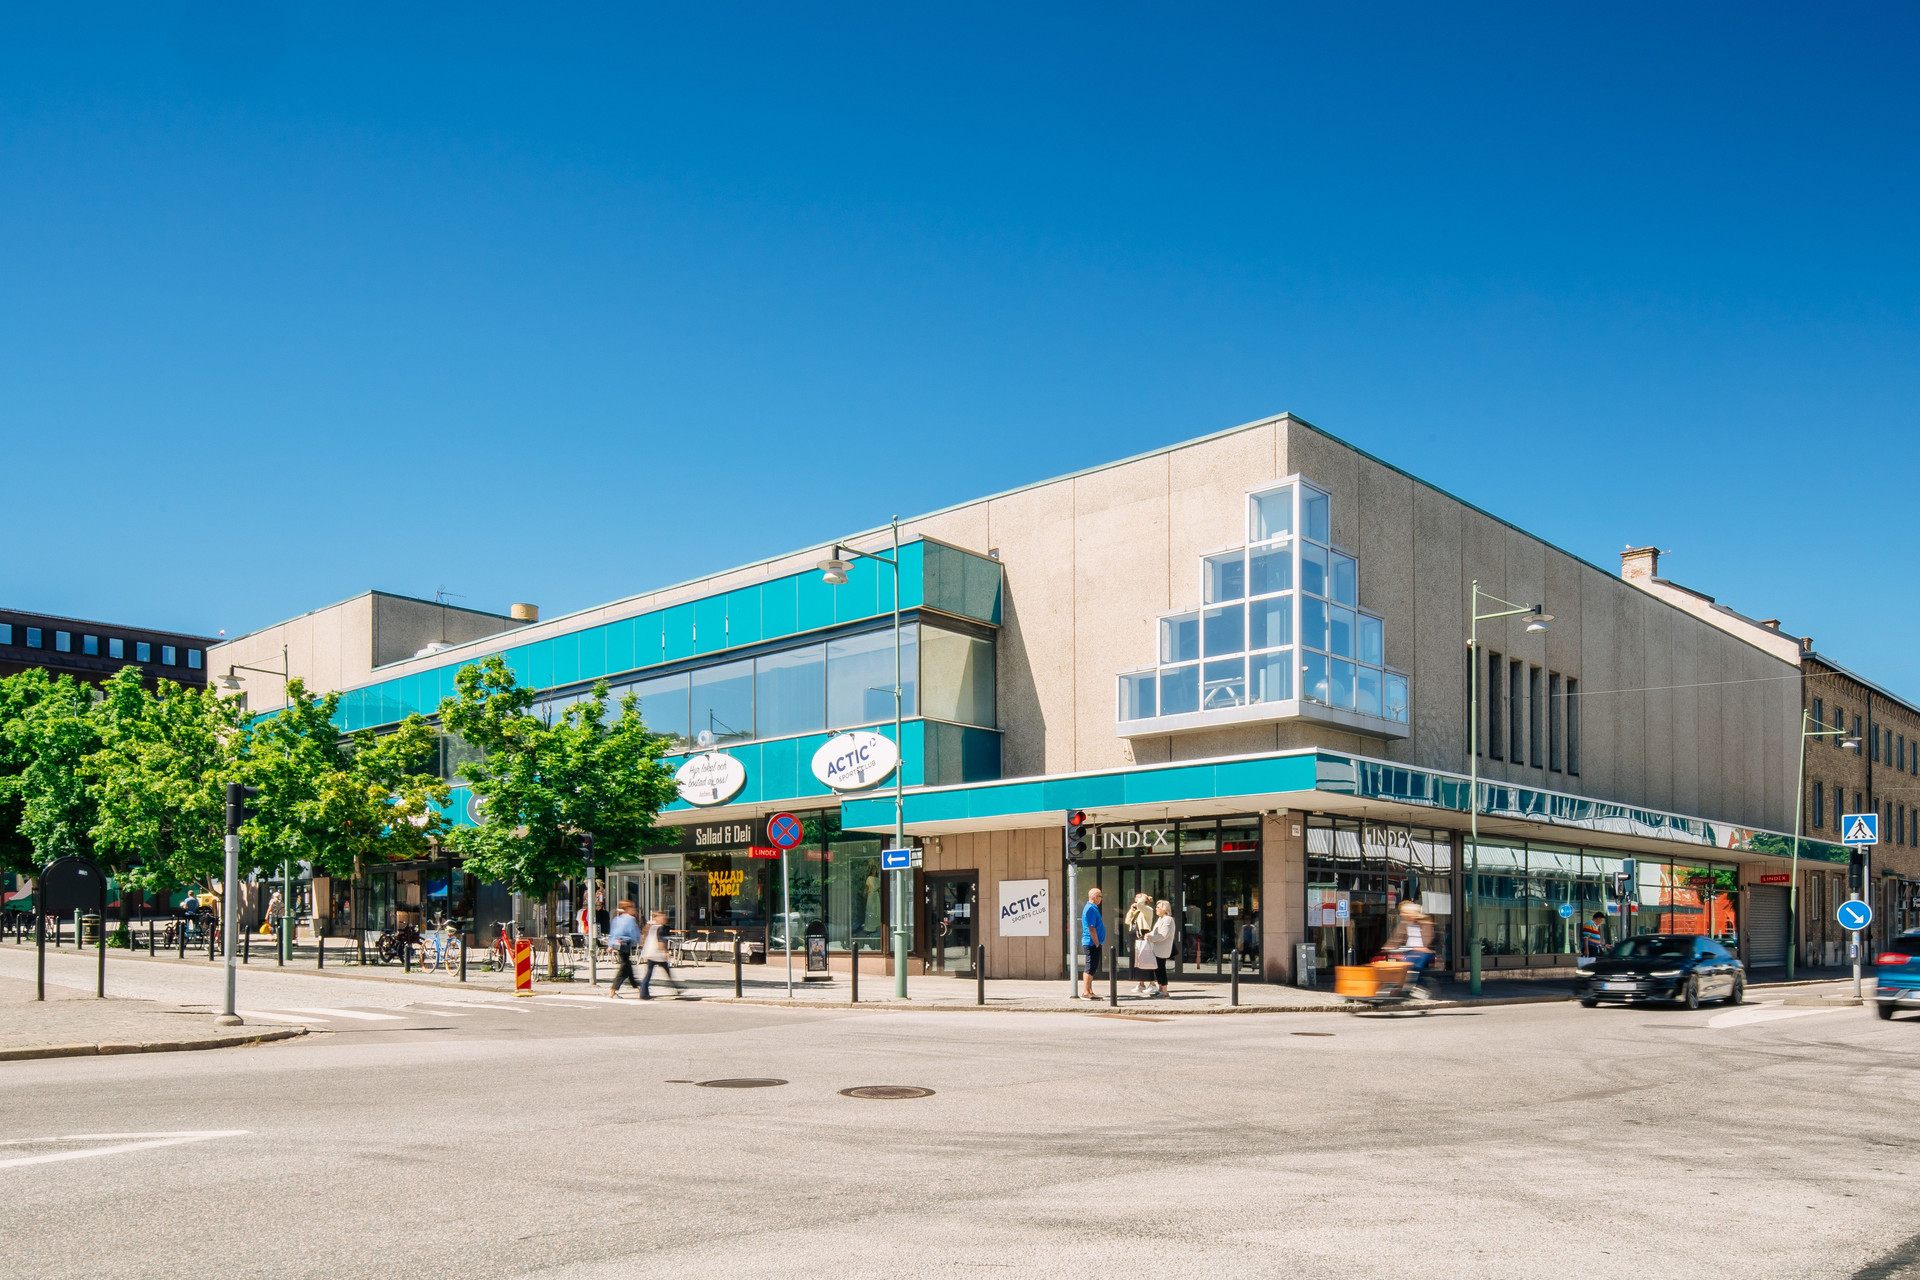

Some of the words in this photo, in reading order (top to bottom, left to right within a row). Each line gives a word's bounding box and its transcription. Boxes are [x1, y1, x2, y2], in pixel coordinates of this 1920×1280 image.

[827, 745, 870, 778] ACTIC
[696, 826, 723, 846] Sallad
[725, 826, 732, 844] &
[734, 824, 751, 843] Deli
[1091, 828, 1168, 850] LINDEX
[1364, 827, 1413, 848] LINDEX
[754, 849, 777, 857] LINDEX
[708, 869, 744, 884] SALLAD
[1001, 894, 1040, 919] ACTIC
[1012, 911, 1032, 923] SPORTS
[1031, 907, 1046, 916] CLUB
